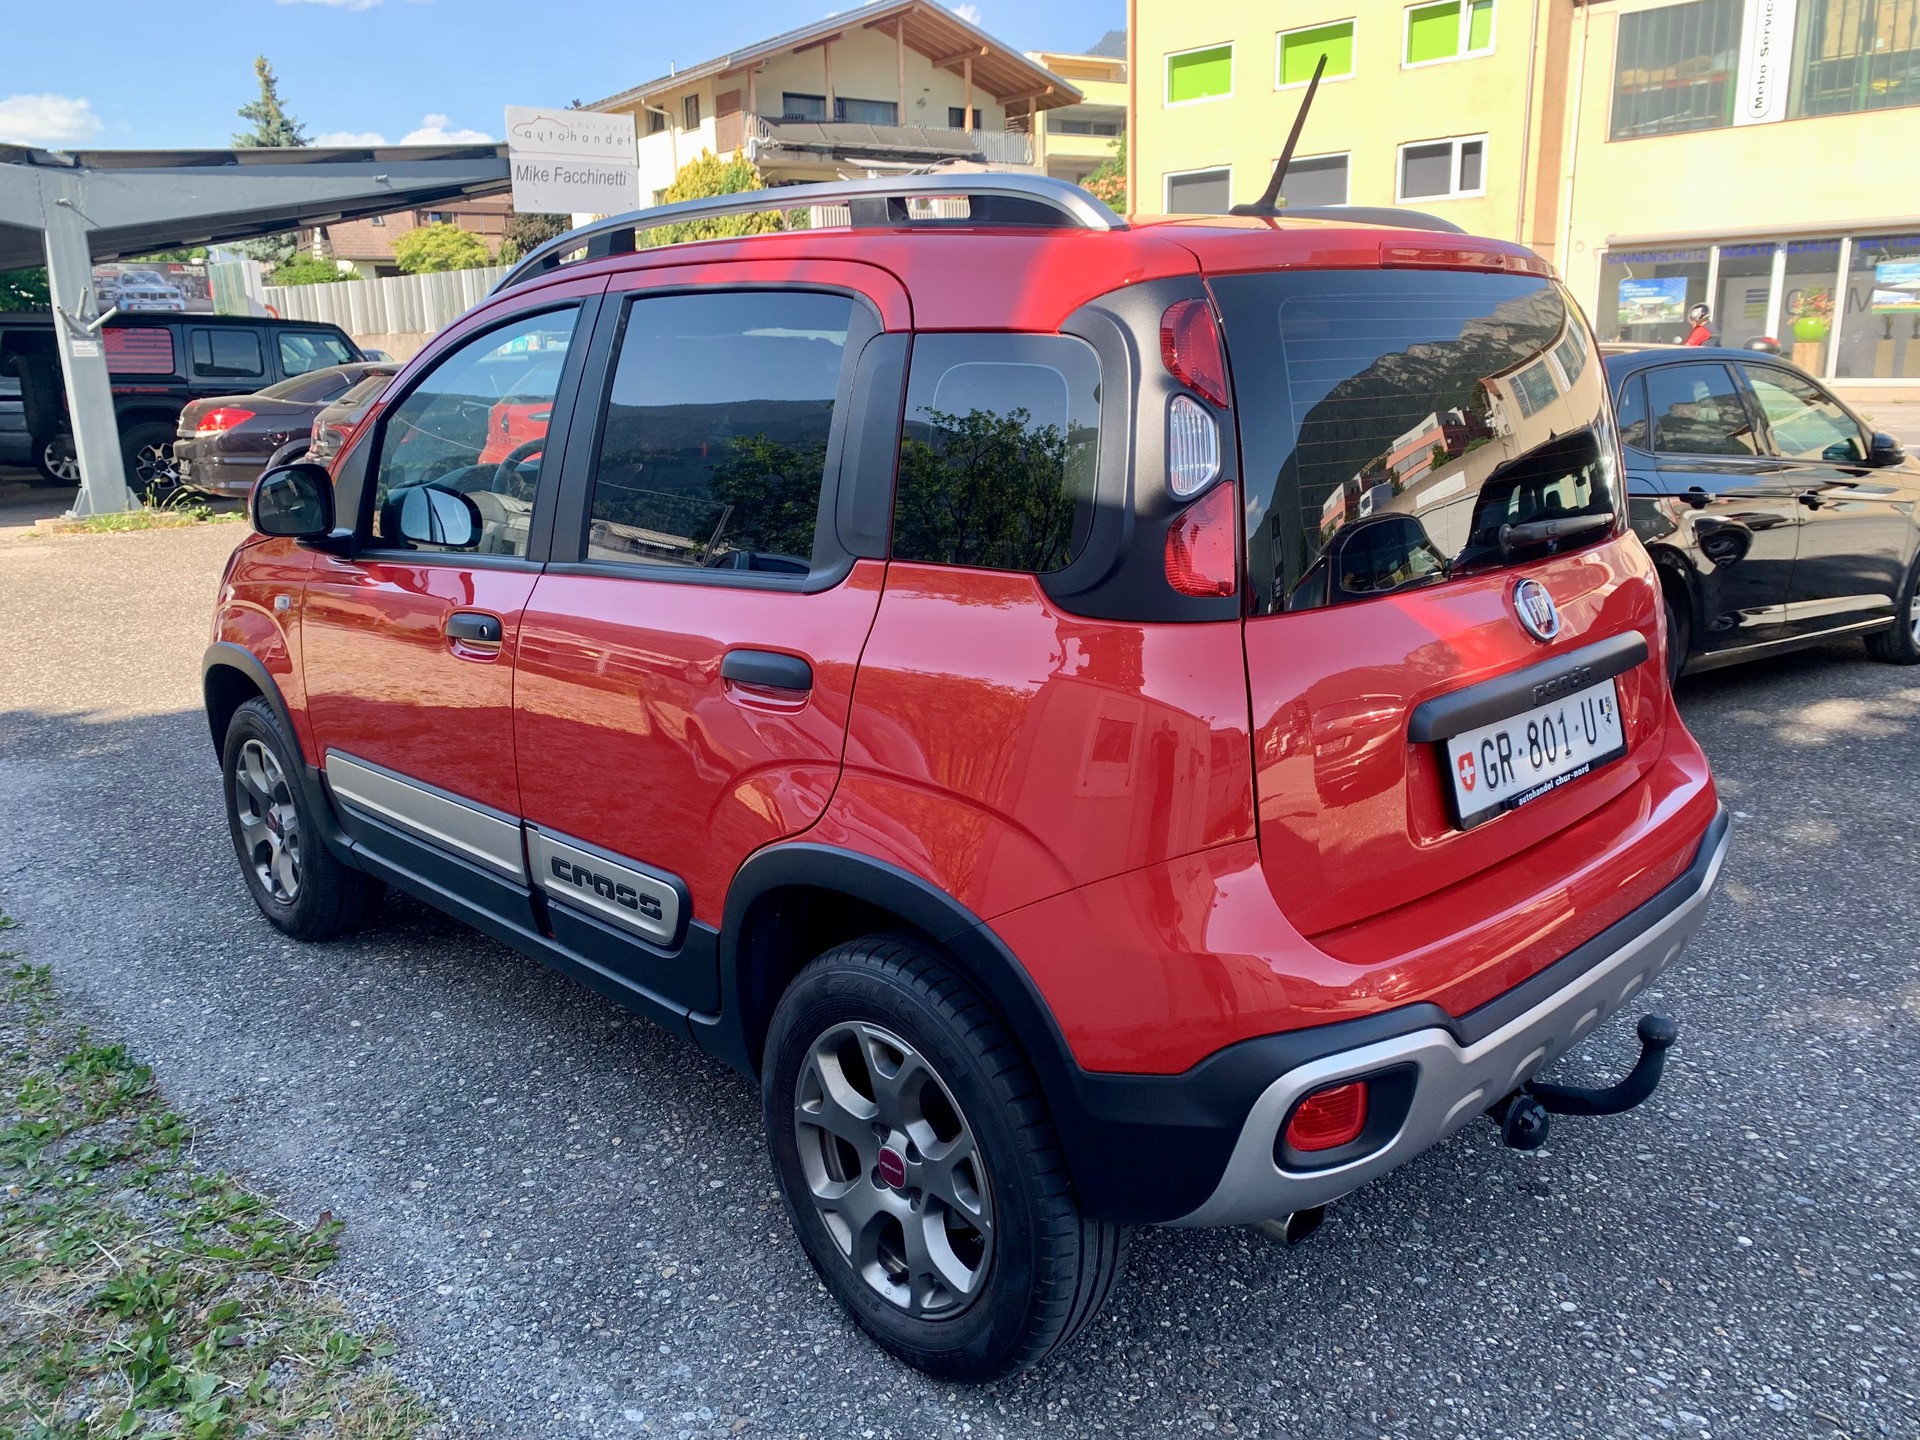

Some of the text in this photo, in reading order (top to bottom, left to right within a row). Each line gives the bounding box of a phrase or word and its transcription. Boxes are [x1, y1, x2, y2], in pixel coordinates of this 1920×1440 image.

[1754, 64, 1767, 109] Mebo
[516, 165, 627, 186] Mike Facchinetti
[1606, 247, 1707, 265] SONNENSCHUTZ
[1525, 595, 1552, 625] FIAT
[1518, 763, 1590, 806] autohandel chur-nord
